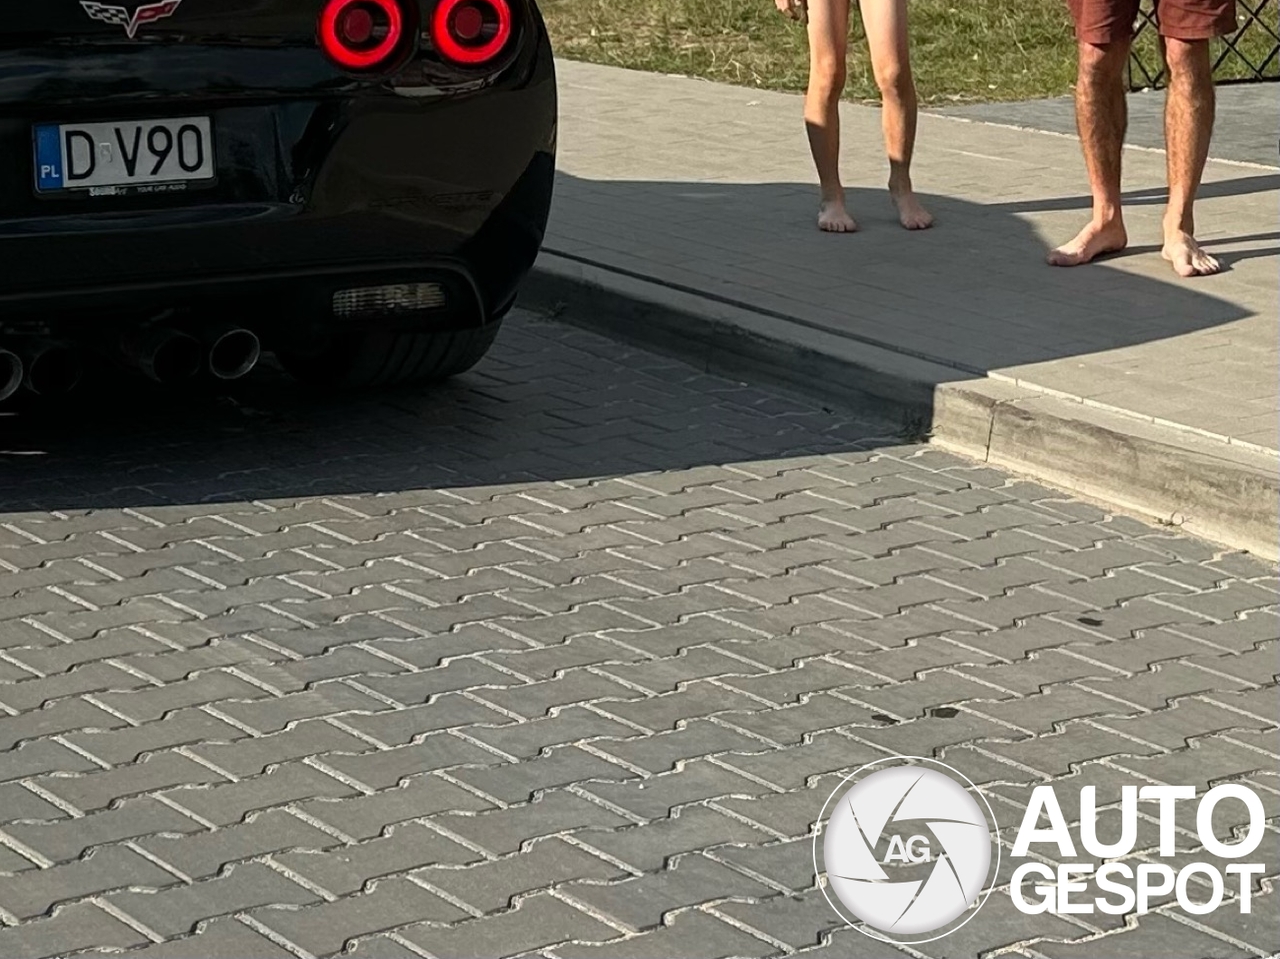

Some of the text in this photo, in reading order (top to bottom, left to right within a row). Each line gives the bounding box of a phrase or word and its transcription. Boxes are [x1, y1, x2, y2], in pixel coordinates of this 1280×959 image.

[41, 123, 204, 180] PL D V90
